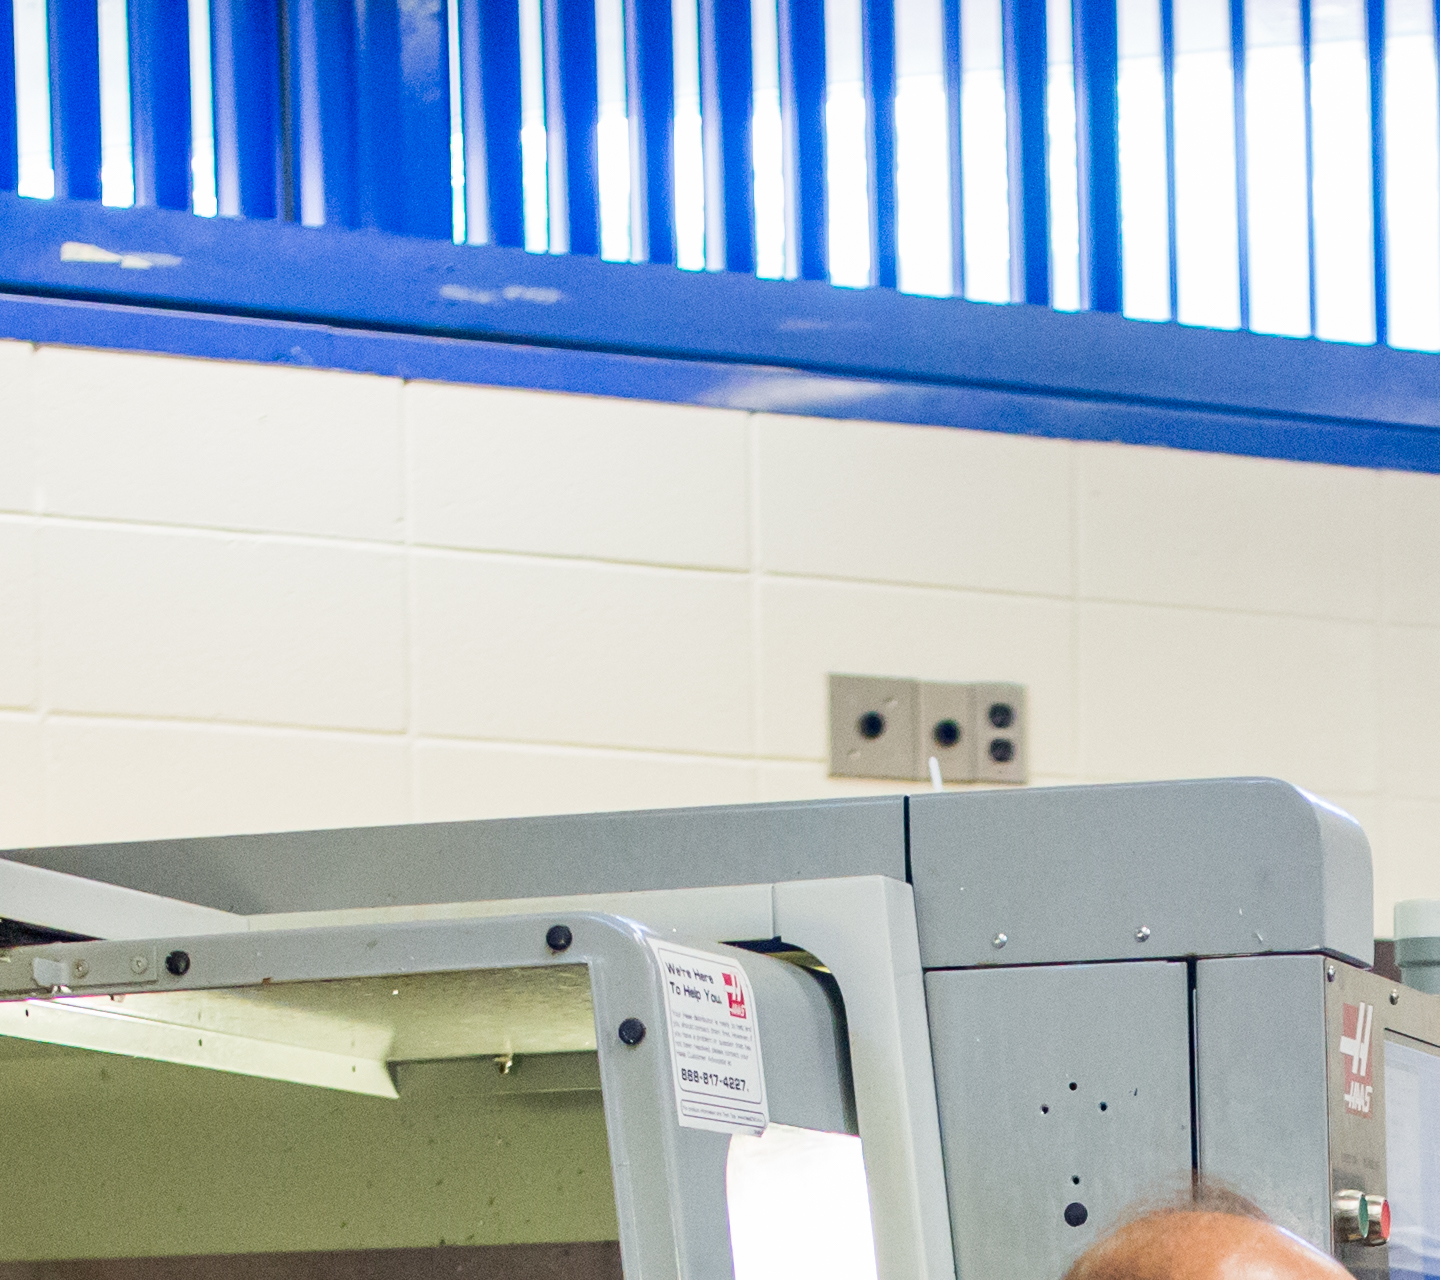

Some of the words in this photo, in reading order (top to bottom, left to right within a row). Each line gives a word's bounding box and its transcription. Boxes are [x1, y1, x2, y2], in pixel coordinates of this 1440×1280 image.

[692, 968, 714, 984] Here
[669, 981, 681, 995] To
[683, 984, 701, 1002] Help
[1343, 1080, 1374, 1113] HAAS
